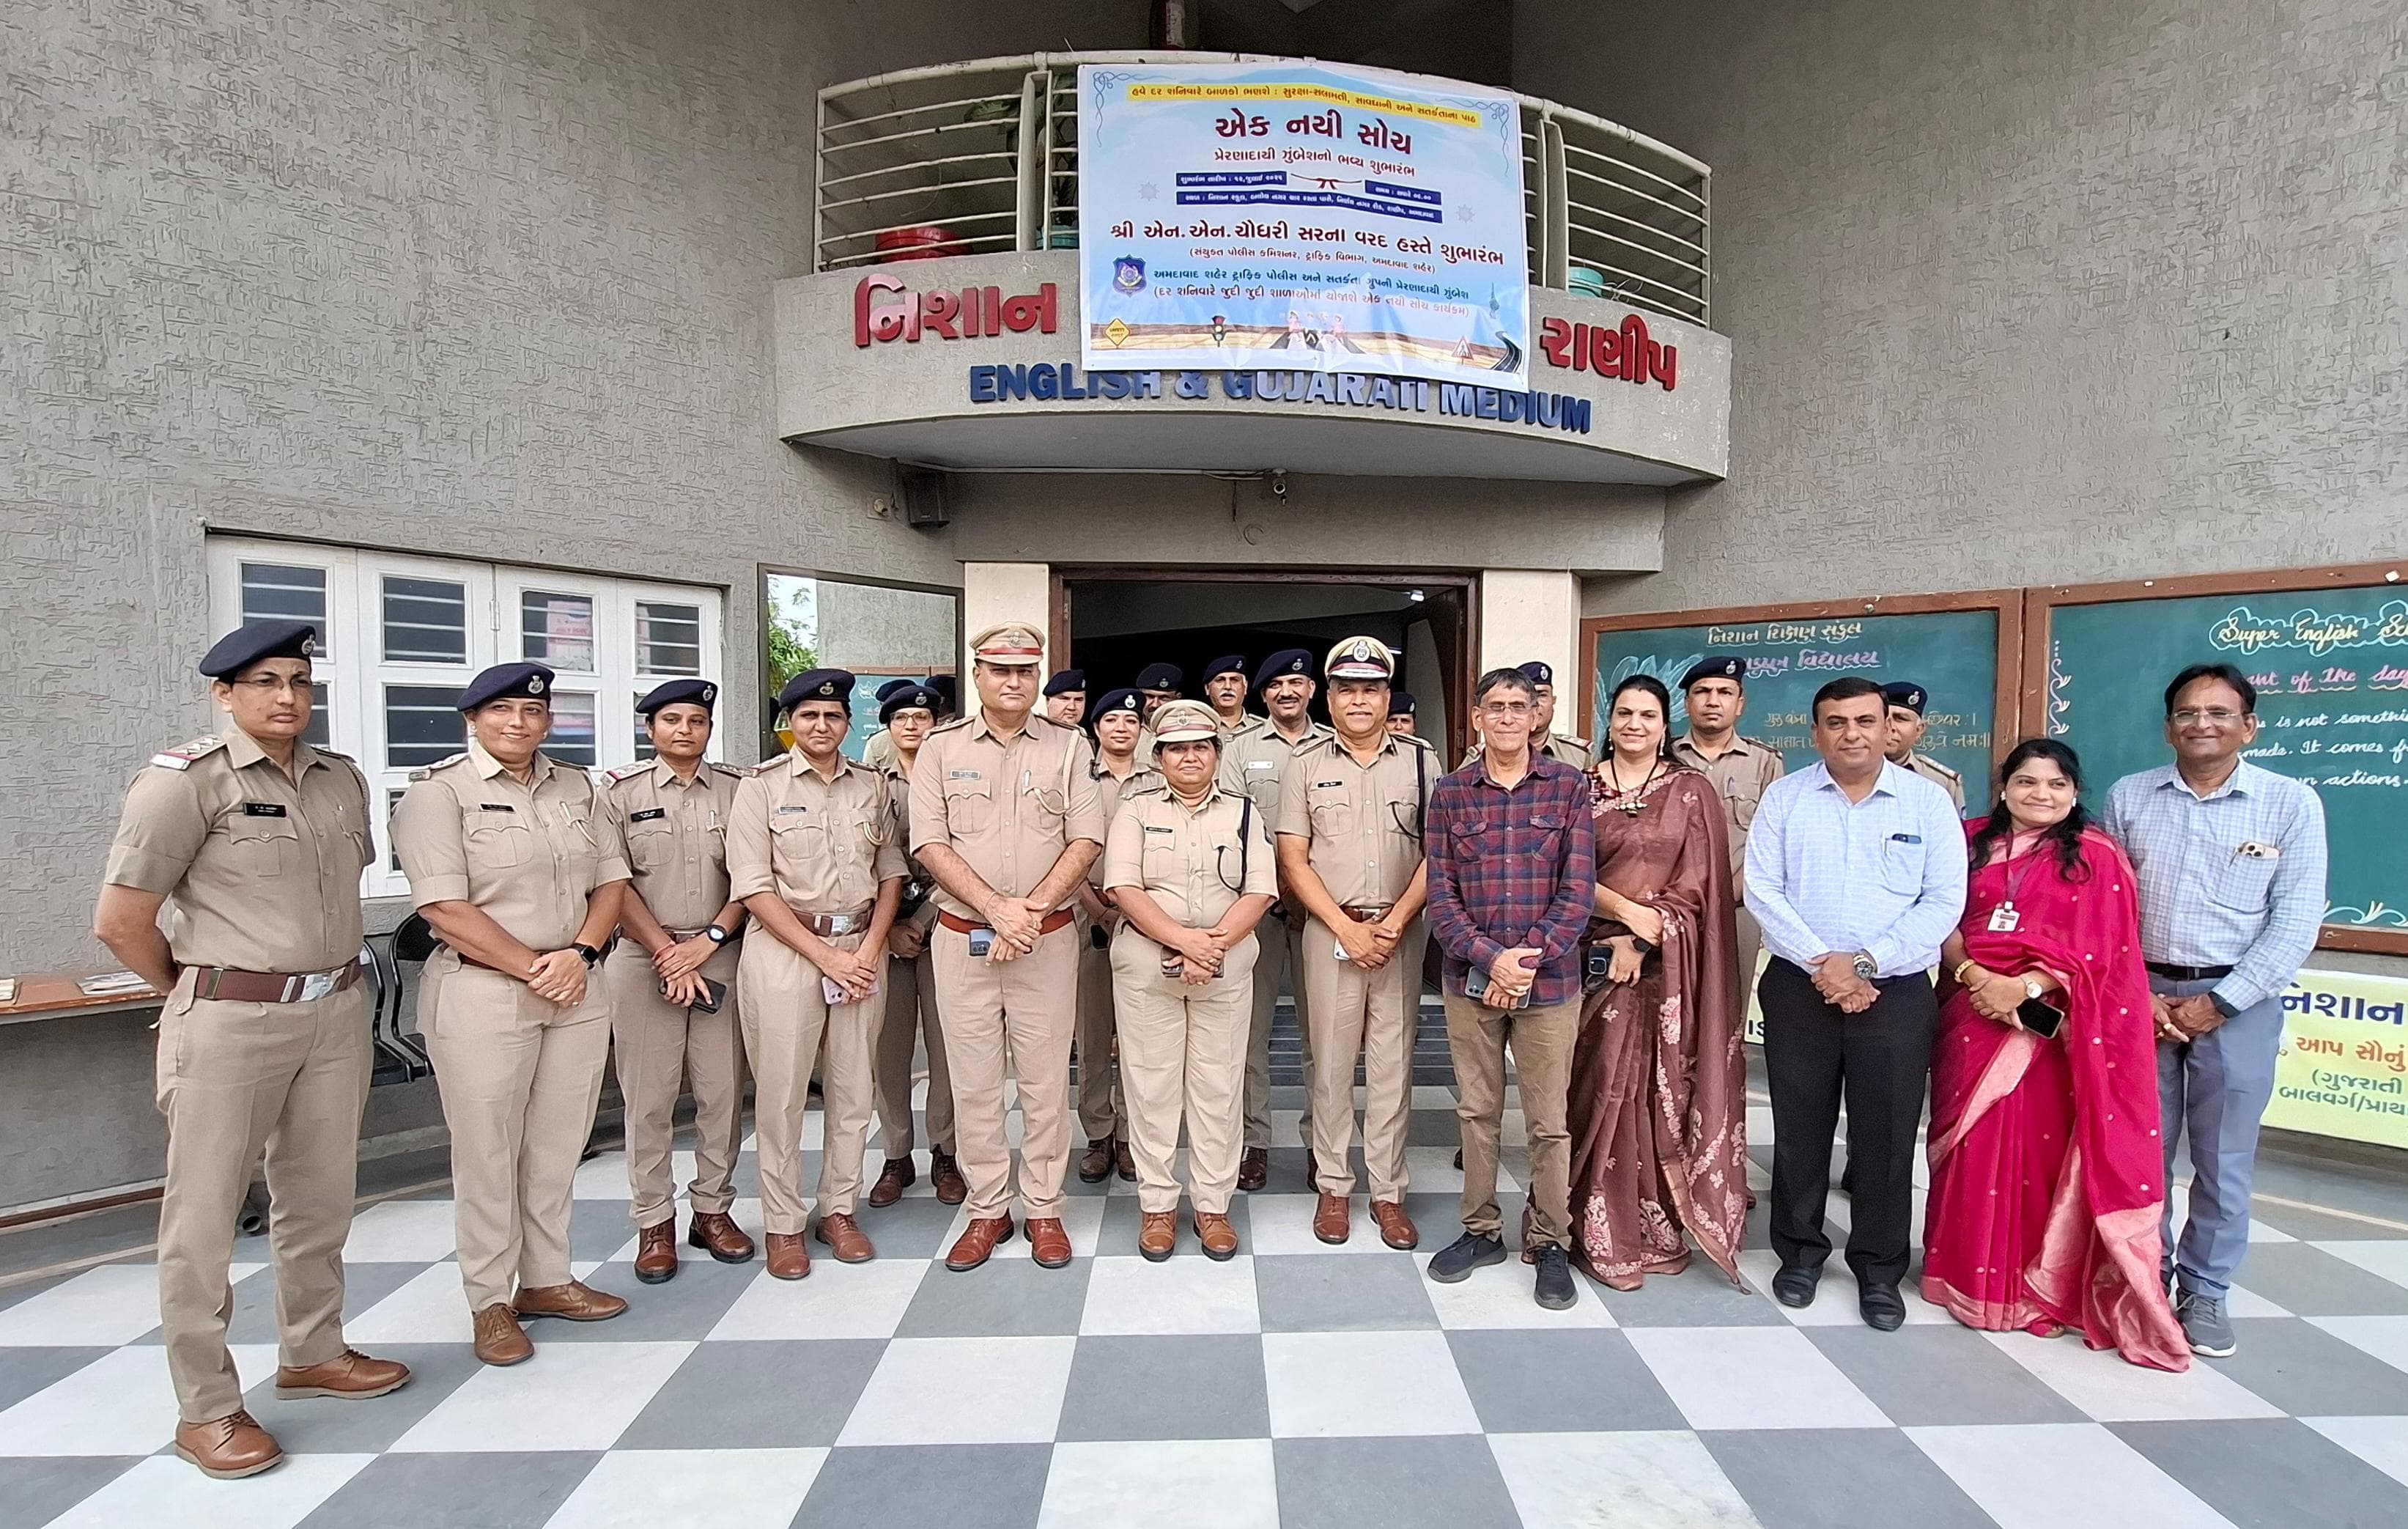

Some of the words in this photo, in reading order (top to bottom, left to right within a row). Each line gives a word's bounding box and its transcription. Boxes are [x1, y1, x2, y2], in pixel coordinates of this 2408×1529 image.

[1167, 85, 1202, 96] શનિવારે
[1206, 86, 1238, 96] બાળકો
[1243, 85, 1270, 96] ભણશે
[1396, 102, 1413, 113] અને
[1215, 108, 1271, 138] એક
[1357, 117, 1411, 155] સોચ
[1214, 147, 1275, 163] પ્રેરણાદાયી
[1337, 153, 1364, 169] ભવ્ય
[1370, 158, 1415, 177] શુભારંભ
[1110, 219, 1134, 239] શ્રી
[1298, 226, 1345, 243] સરના
[1354, 227, 1389, 248] વરદ
[1396, 235, 1432, 255] હસ્તે
[1440, 242, 1504, 266] શુભારંભ
[1227, 245, 1255, 257] પોલીસ
[1335, 250, 1367, 264] વિભાગ,
[1372, 256, 1409, 270] અમદાવાદ
[1153, 269, 1200, 279] અમદાવાદ
[1204, 268, 1227, 279] શહેર
[1266, 268, 1297, 281] પોલીસ
[1301, 272, 1321, 283] અને
[1177, 283, 1216, 296] શનિવારે
[1221, 284, 1241, 300] જુદી
[1244, 285, 1264, 301] જુદી
[854, 273, 1057, 349] નિશાન
[1540, 313, 1677, 391] રાણીપ
[970, 363, 1162, 402] ENGLISH
[1174, 371, 1209, 399] &
[1222, 371, 1428, 412] GUJARATI
[1439, 383, 1591, 434] MEDIUM
[1707, 626, 1759, 645] નિશાન
[2217, 616, 2280, 649] Super
[2294, 617, 2359, 652] English
[2291, 670, 2313, 693] of
[2275, 715, 2291, 728] is
[2294, 712, 2330, 728] not
[2300, 739, 2322, 755] It
[2324, 742, 2384, 755] comes
[2296, 1036, 2344, 1057] આપ
[2355, 1039, 2407, 1072] સૌનું
[2311, 1068, 2402, 1095] (ગુજરાતી
